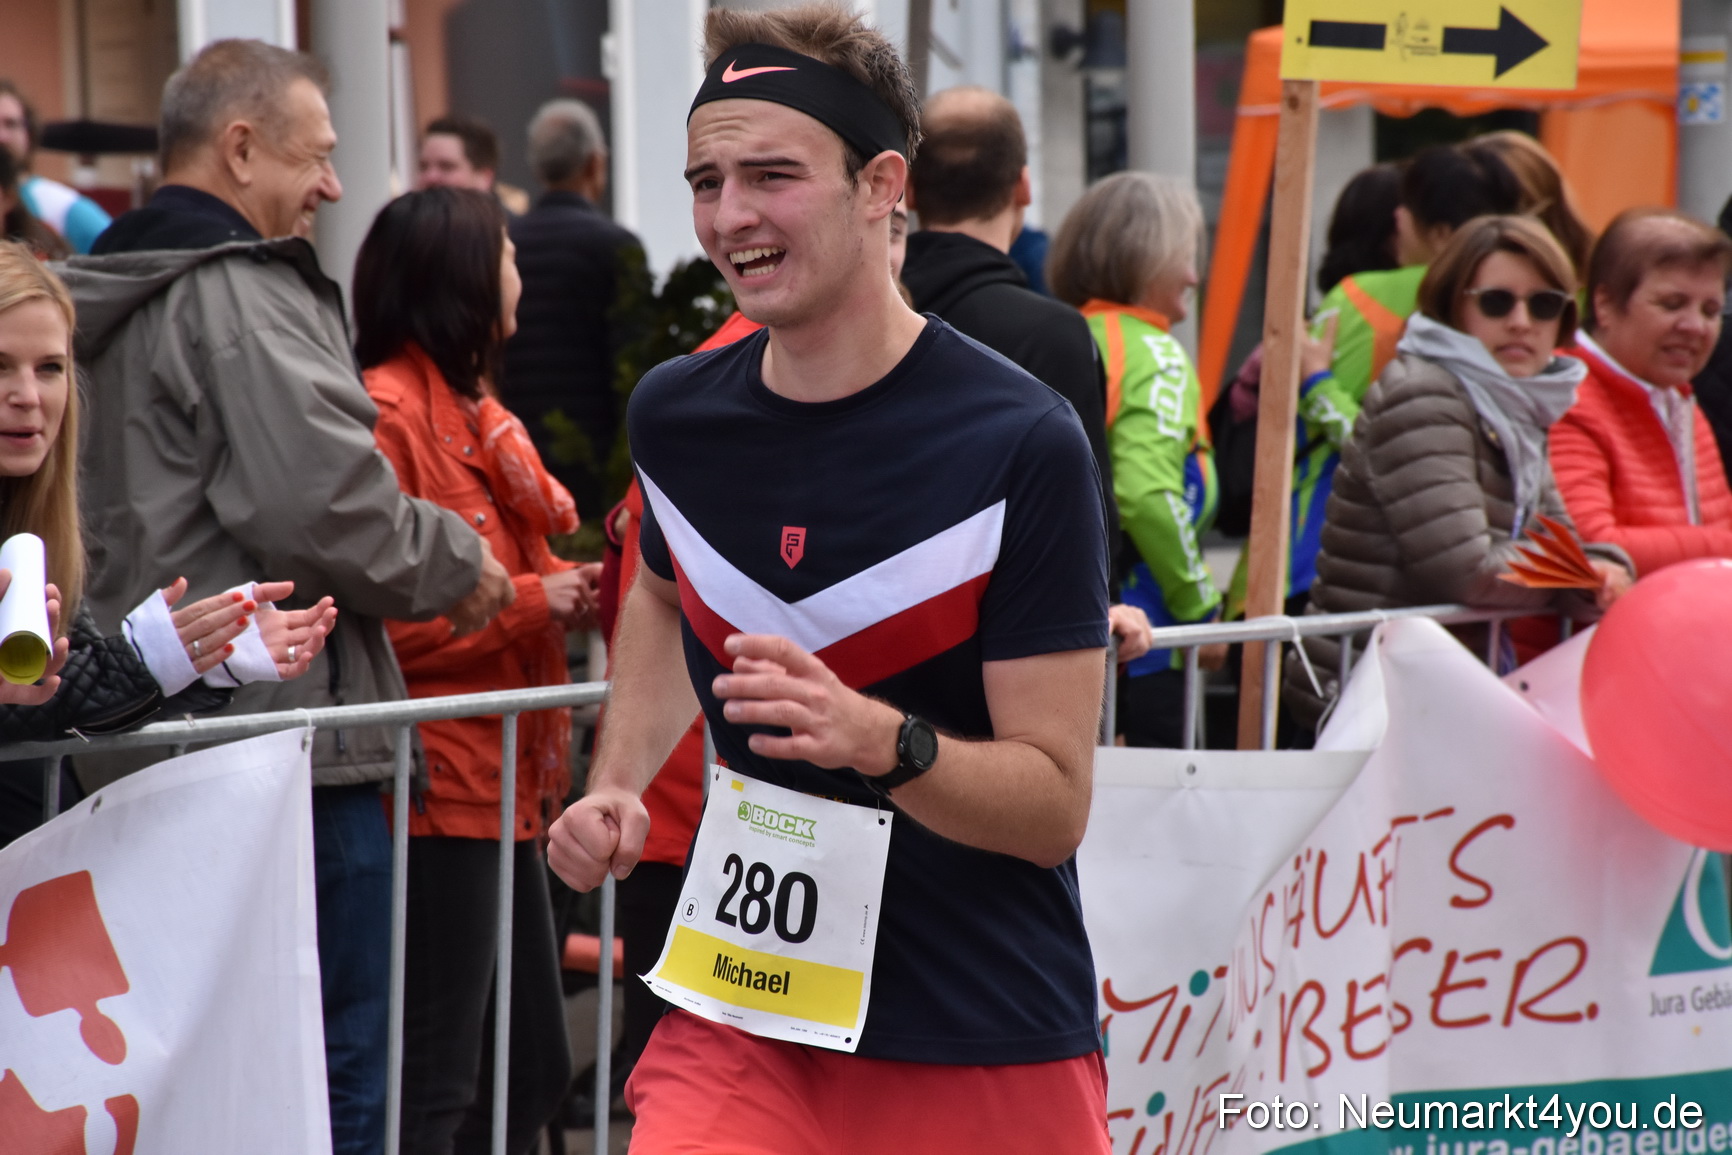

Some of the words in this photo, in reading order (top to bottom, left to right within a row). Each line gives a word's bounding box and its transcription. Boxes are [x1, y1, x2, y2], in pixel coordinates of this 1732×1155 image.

[750, 804, 817, 840] BOCK
[772, 833, 788, 842] smart
[788, 837, 816, 848] concepts
[686, 903, 695, 917] B
[715, 853, 818, 944] 280
[712, 953, 791, 996] Michael
[1649, 991, 1685, 1018] Jura
